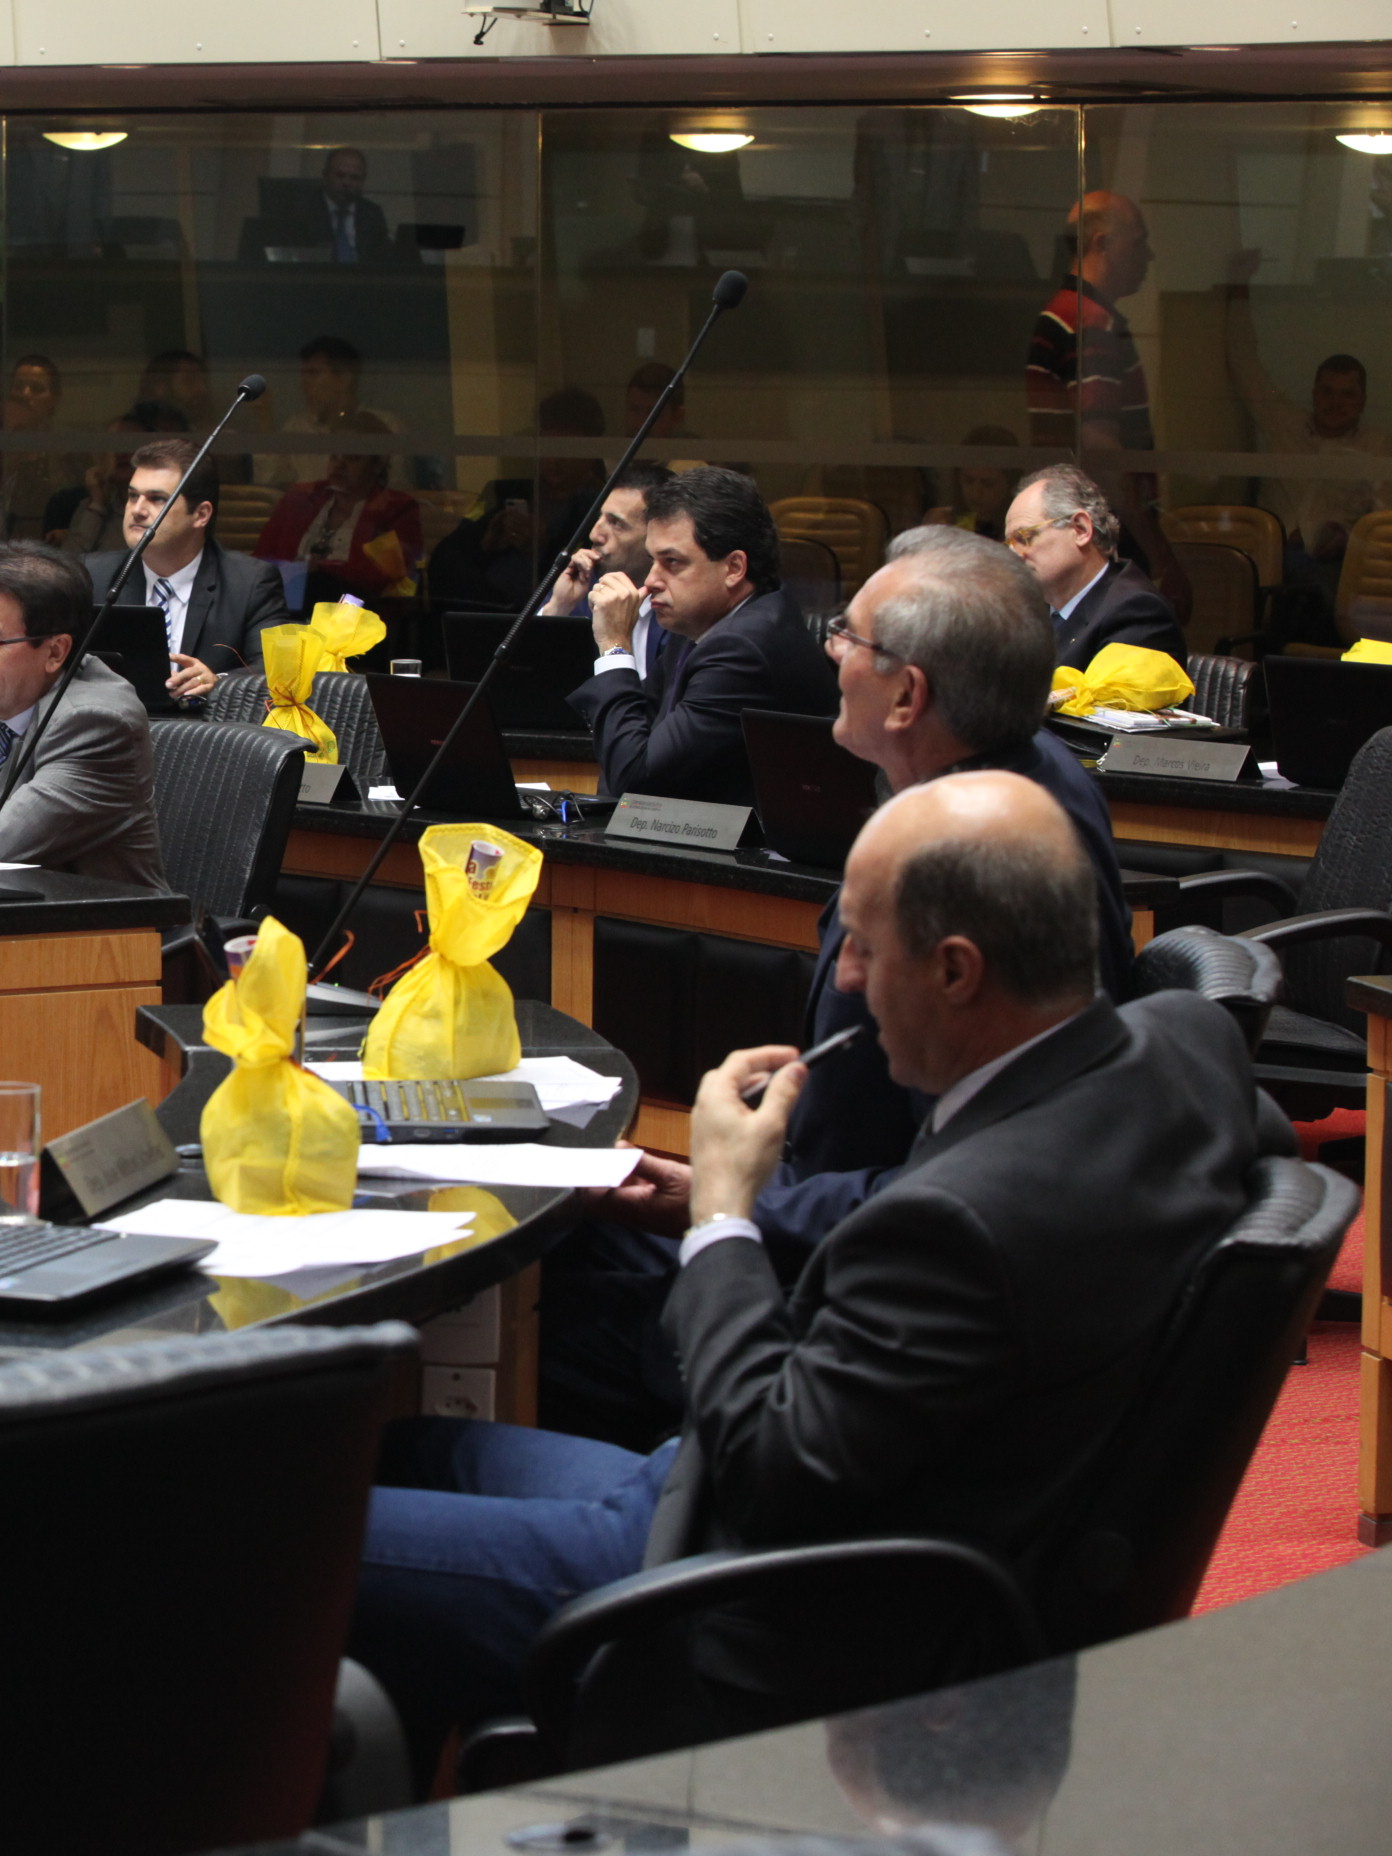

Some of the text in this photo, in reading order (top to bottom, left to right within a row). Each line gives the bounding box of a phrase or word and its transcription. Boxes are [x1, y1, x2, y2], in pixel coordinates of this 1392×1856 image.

[1132, 755, 1151, 768] Dep.
[630, 816, 718, 839] Dep. Narcizo Parisotto
